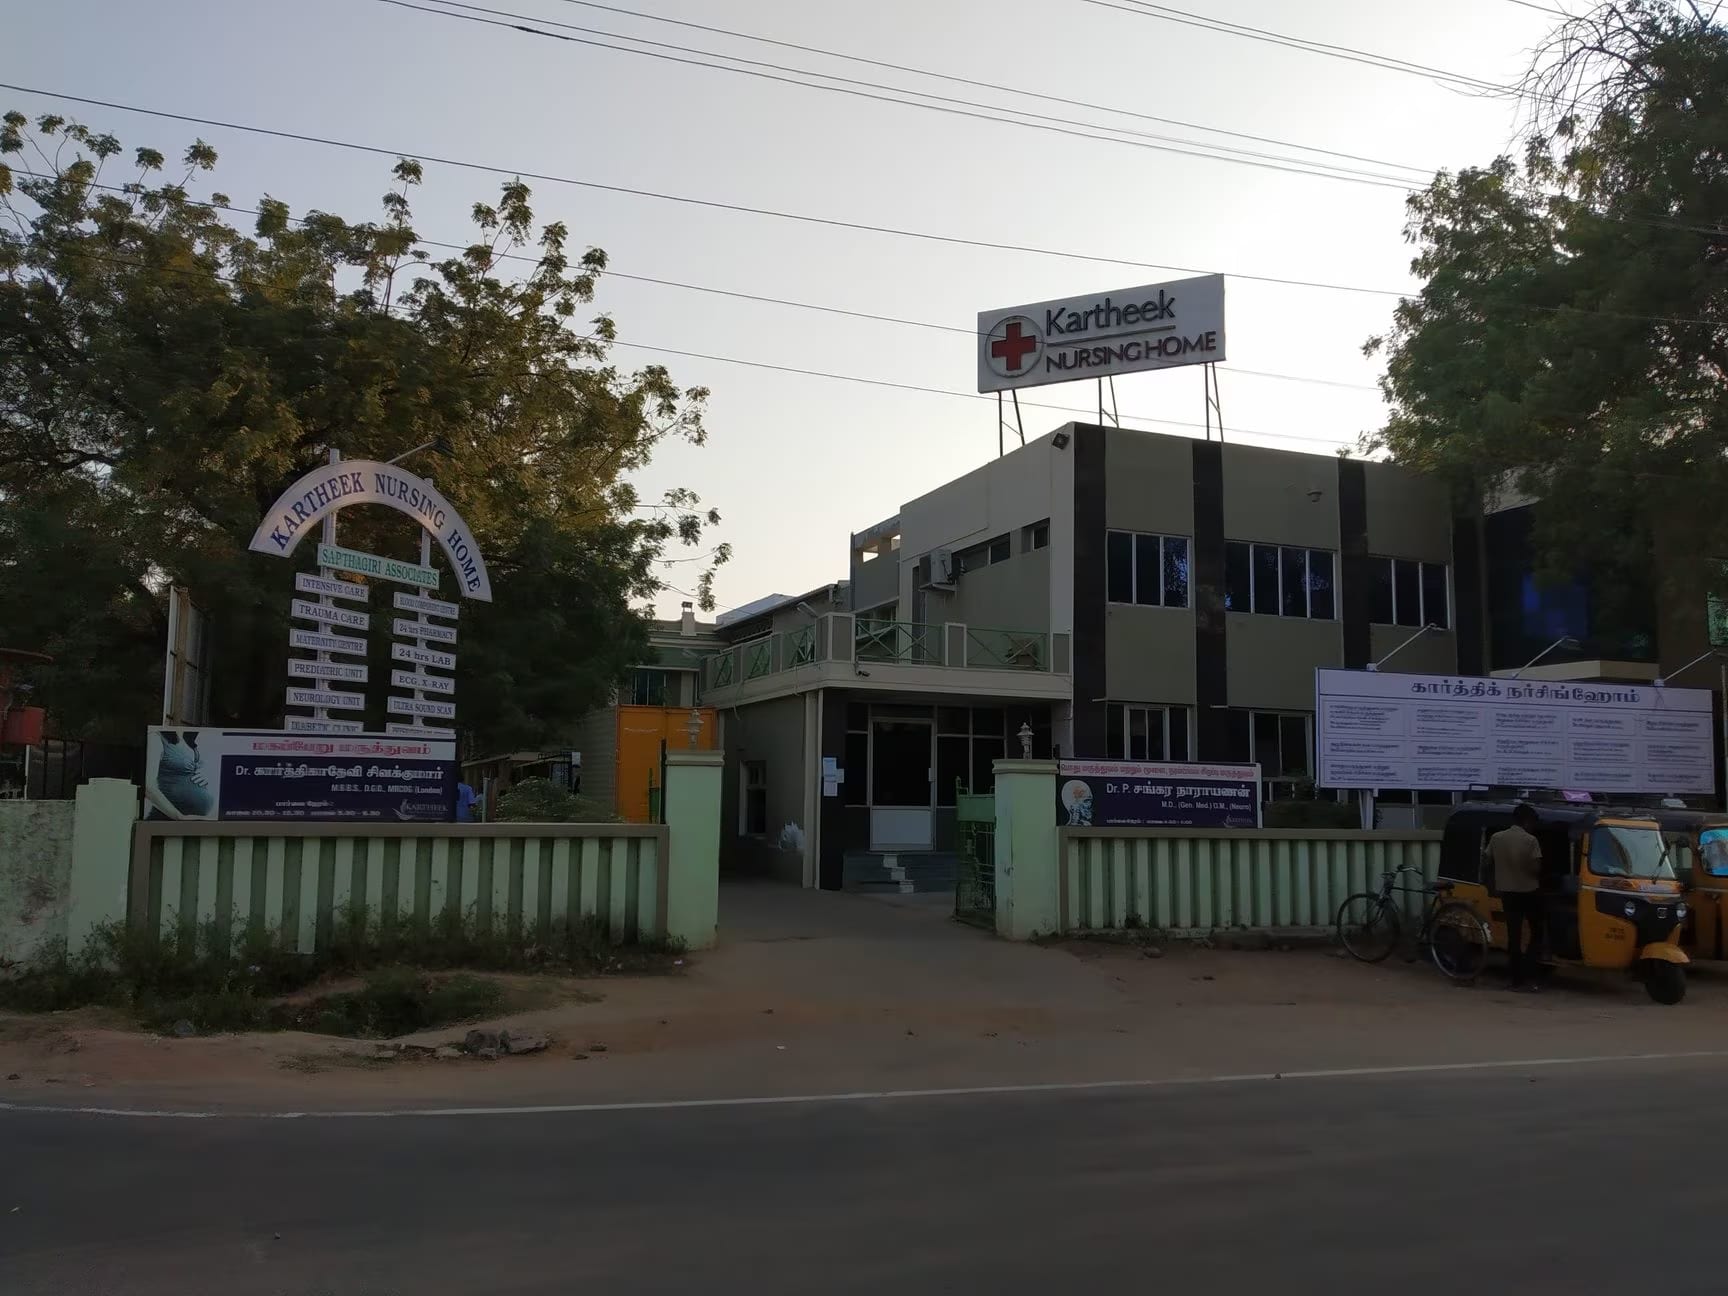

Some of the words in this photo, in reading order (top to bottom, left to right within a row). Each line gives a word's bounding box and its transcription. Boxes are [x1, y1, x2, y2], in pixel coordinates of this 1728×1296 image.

[1046, 289, 1175, 336] Kartheek
[271, 471, 365, 550] KARTHEEK
[375, 473, 446, 529] NURSING
[447, 529, 481, 592] HOME
[322, 548, 381, 573] SAPTHAGIRI
[384, 563, 438, 586] ASSOCIATES
[302, 577, 343, 593] INTENSIVE
[344, 585, 366, 598] CARE
[299, 604, 339, 620] TRAUMA
[340, 613, 366, 626] CARE
[296, 633, 337, 648] MATERNITY
[399, 647, 411, 658] 24
[414, 651, 430, 662] hrs
[431, 653, 452, 667] LAB
[294, 663, 343, 677] PREDIATRIC
[344, 667, 363, 679] UNIT
[1412, 679, 1502, 698] கார்த்திக்
[293, 692, 341, 705] NEUROLOGY
[236, 765, 251, 776] Dr.
[1106, 783, 1120, 794] Dr.
[1122, 783, 1131, 794] P.
[1133, 780, 1174, 798] சங்கர
[1175, 784, 1251, 798] நாராயணன்
